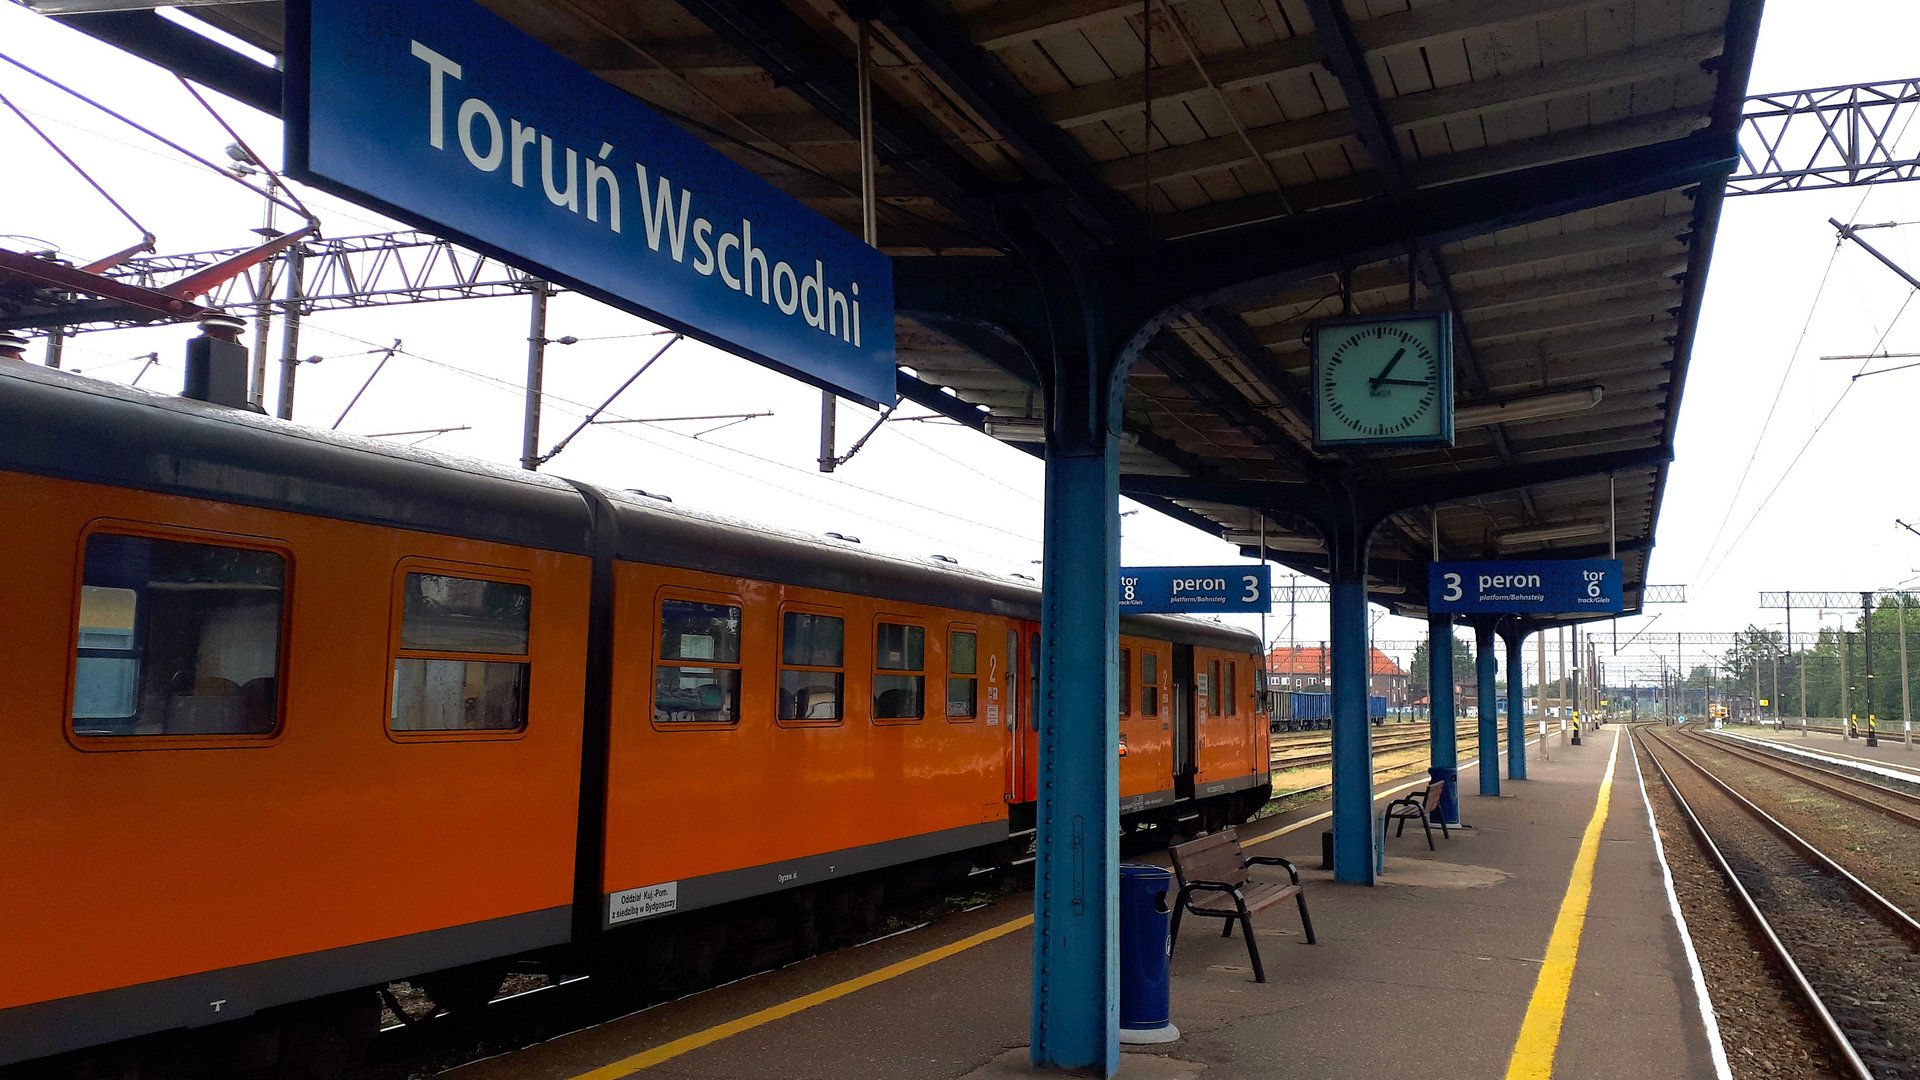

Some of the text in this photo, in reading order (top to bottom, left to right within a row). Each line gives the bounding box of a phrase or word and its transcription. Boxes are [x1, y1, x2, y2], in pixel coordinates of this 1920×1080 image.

[411, 39, 861, 348] Toruń Wschodni
[1120, 576, 1139, 586] tor
[1583, 570, 1605, 581] tor
[1124, 585, 1135, 600] 8
[1173, 575, 1260, 603] peron 3
[1443, 572, 1541, 602] 3 peron
[1588, 581, 1601, 597] 6
[1170, 596, 1227, 604] platform/Bahnsteig
[1479, 594, 1545, 602] platform/Bahnsteig
[989, 654, 997, 683] 2
[611, 911, 616, 919] z
[616, 907, 639, 918] siedzibą
[645, 899, 676, 913] Bydgoszczy
